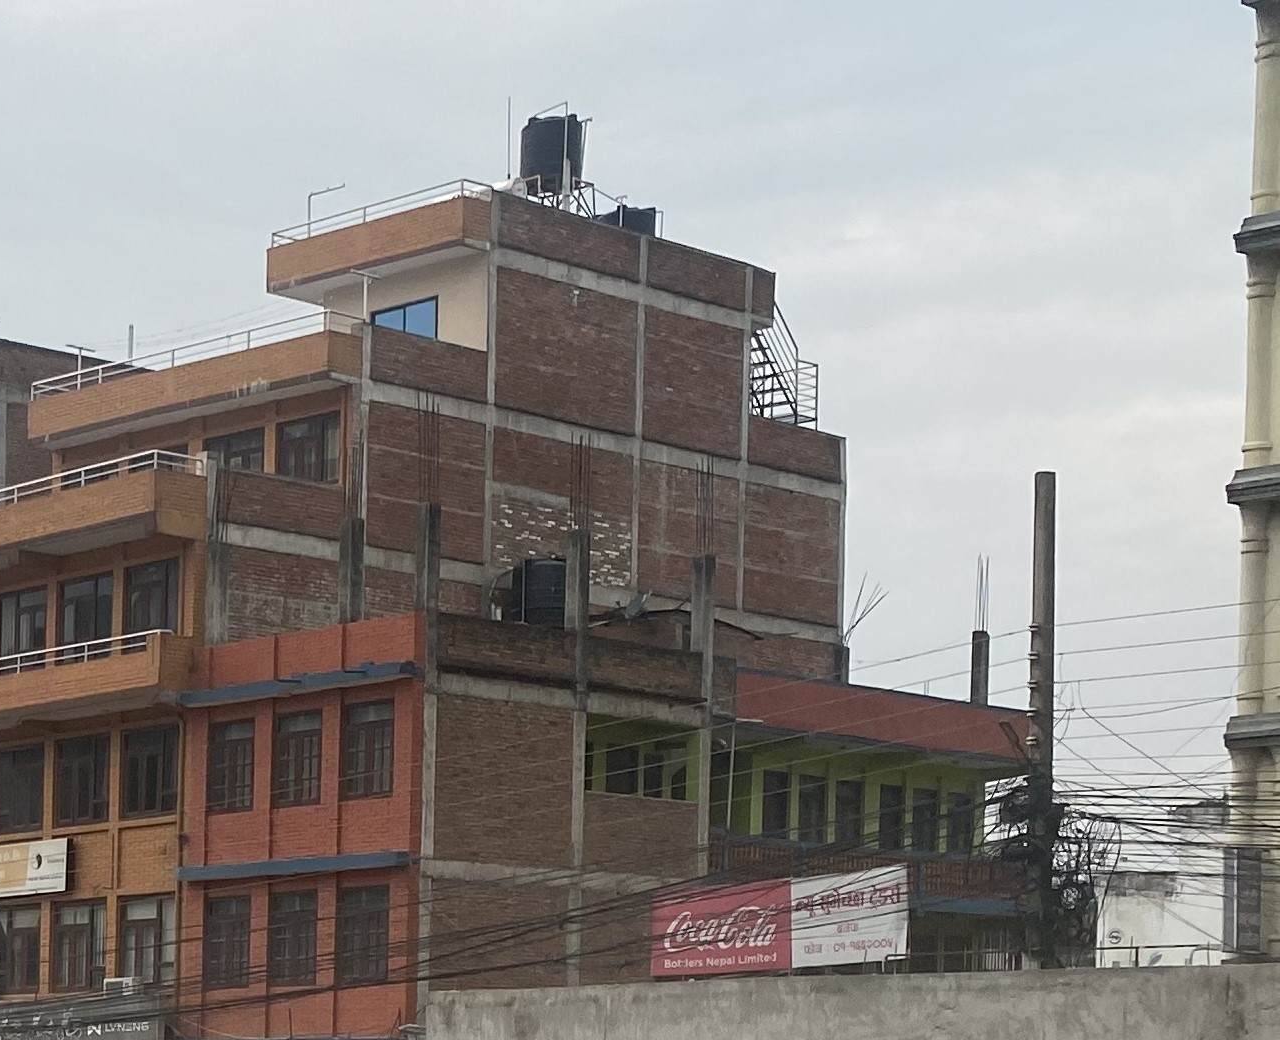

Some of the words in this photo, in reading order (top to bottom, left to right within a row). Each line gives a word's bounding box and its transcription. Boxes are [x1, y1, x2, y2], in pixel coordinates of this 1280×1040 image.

[664, 958, 703, 969] Bottlers
[706, 956, 735, 967] Nepal
[738, 952, 777, 965] Limited
